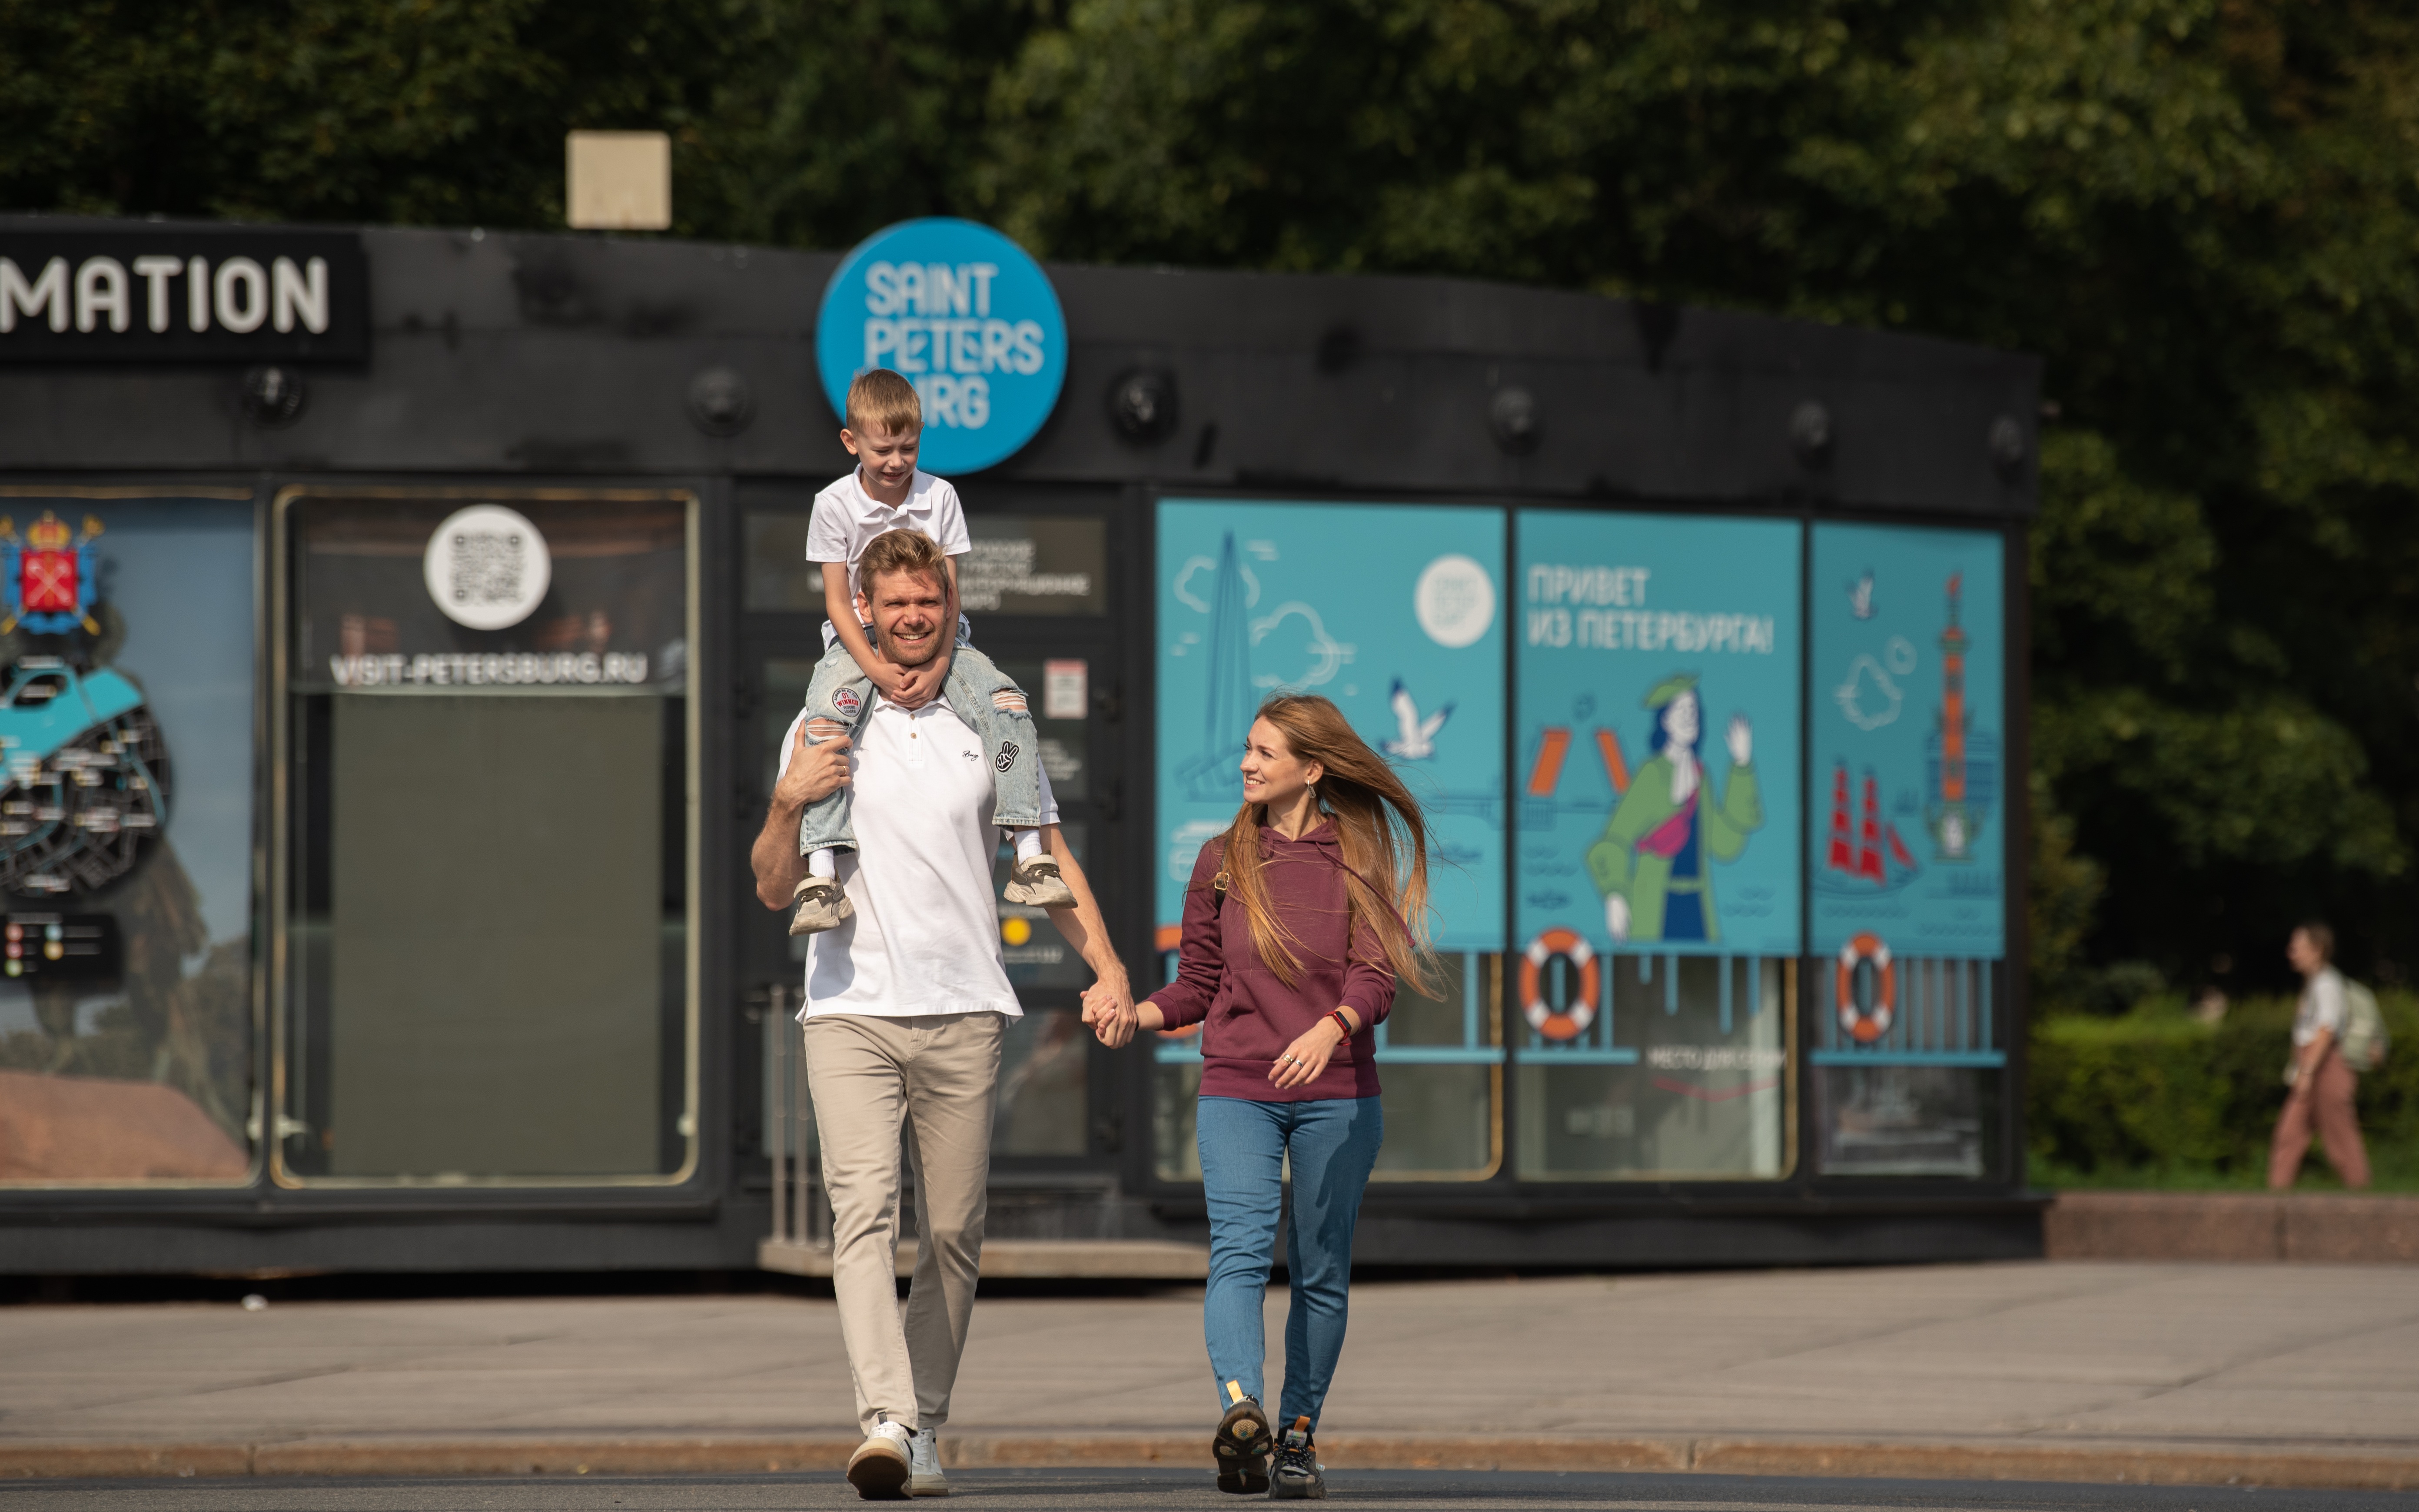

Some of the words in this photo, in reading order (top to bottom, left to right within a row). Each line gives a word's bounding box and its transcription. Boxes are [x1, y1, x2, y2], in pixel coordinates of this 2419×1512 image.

[865, 260, 998, 317] SAINT
[864, 317, 1044, 375] PETERS
[1527, 564, 1650, 607] ПРИВЕТ
[1527, 608, 1572, 648] ИЗ
[1577, 609, 1774, 654] ПЕТЕРБУРГА!
[329, 653, 648, 685] VISIT-PETERSBURG.RU
[837, 699, 858, 707] WINNER
